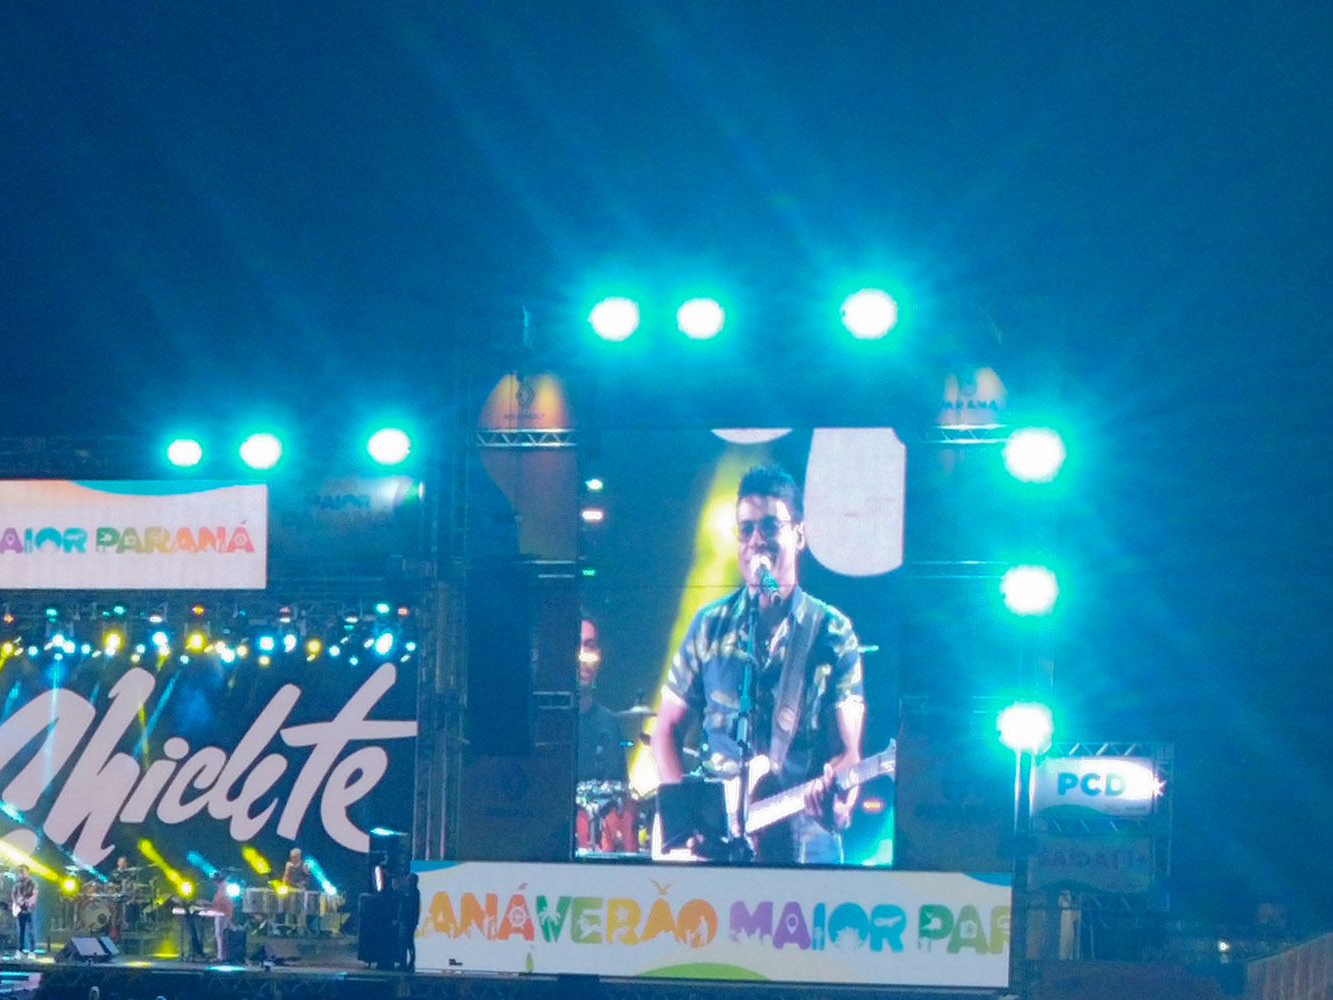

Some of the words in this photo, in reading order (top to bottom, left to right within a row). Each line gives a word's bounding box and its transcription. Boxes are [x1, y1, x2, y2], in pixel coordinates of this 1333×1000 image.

[96, 520, 255, 554] PARANÁ
[1057, 771, 1126, 797] PCD
[535, 878, 718, 949] VERÃO
[729, 900, 908, 953] MAIOR
